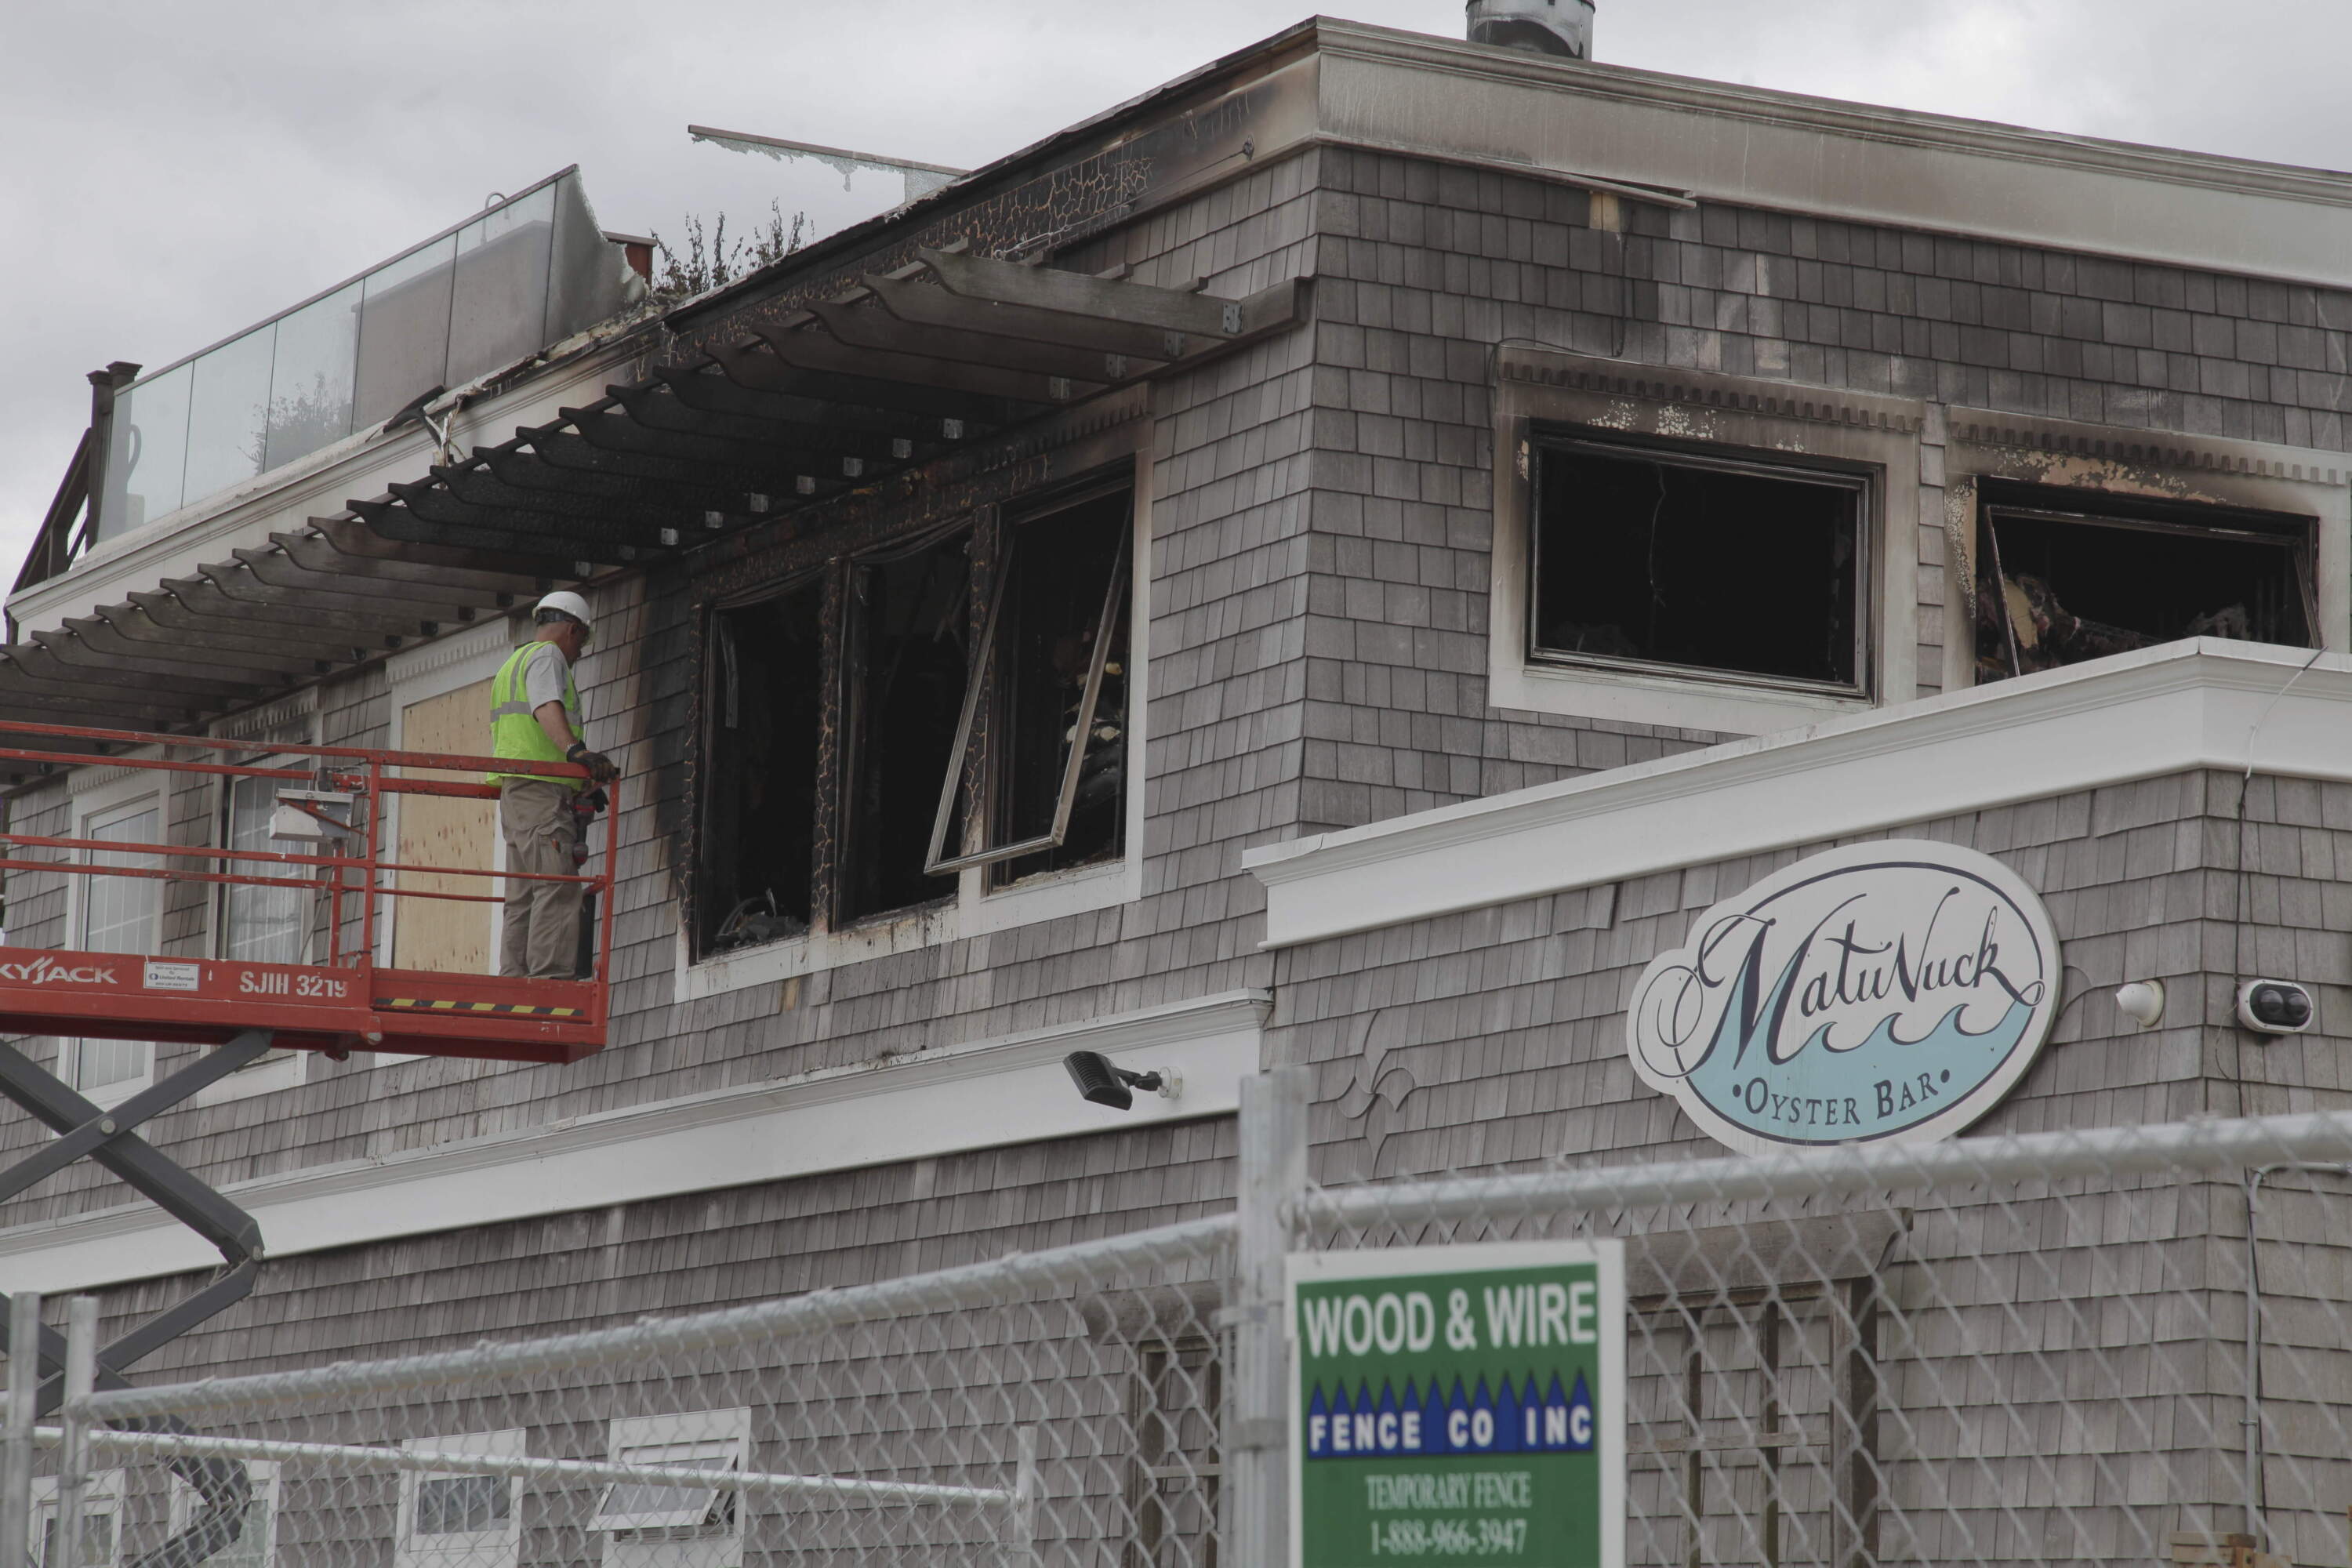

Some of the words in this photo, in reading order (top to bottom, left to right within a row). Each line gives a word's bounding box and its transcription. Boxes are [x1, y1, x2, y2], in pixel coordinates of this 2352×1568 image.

[1745, 1077, 1860, 1125] OYSTER
[1874, 1073, 1939, 1120] BAR
[1303, 1291, 1436, 1358] WOOD
[1445, 1288, 1477, 1351] &
[1483, 1281, 1597, 1348] WIRE
[1309, 1412, 1421, 1452] FENCE
[1447, 1409, 1494, 1448] CO
[1525, 1406, 1592, 1445] INC
[1365, 1473, 1472, 1510] TEMPORARY
[1473, 1472, 1533, 1508] FENCE
[1370, 1518, 1527, 1555] 1-888-966-3947
